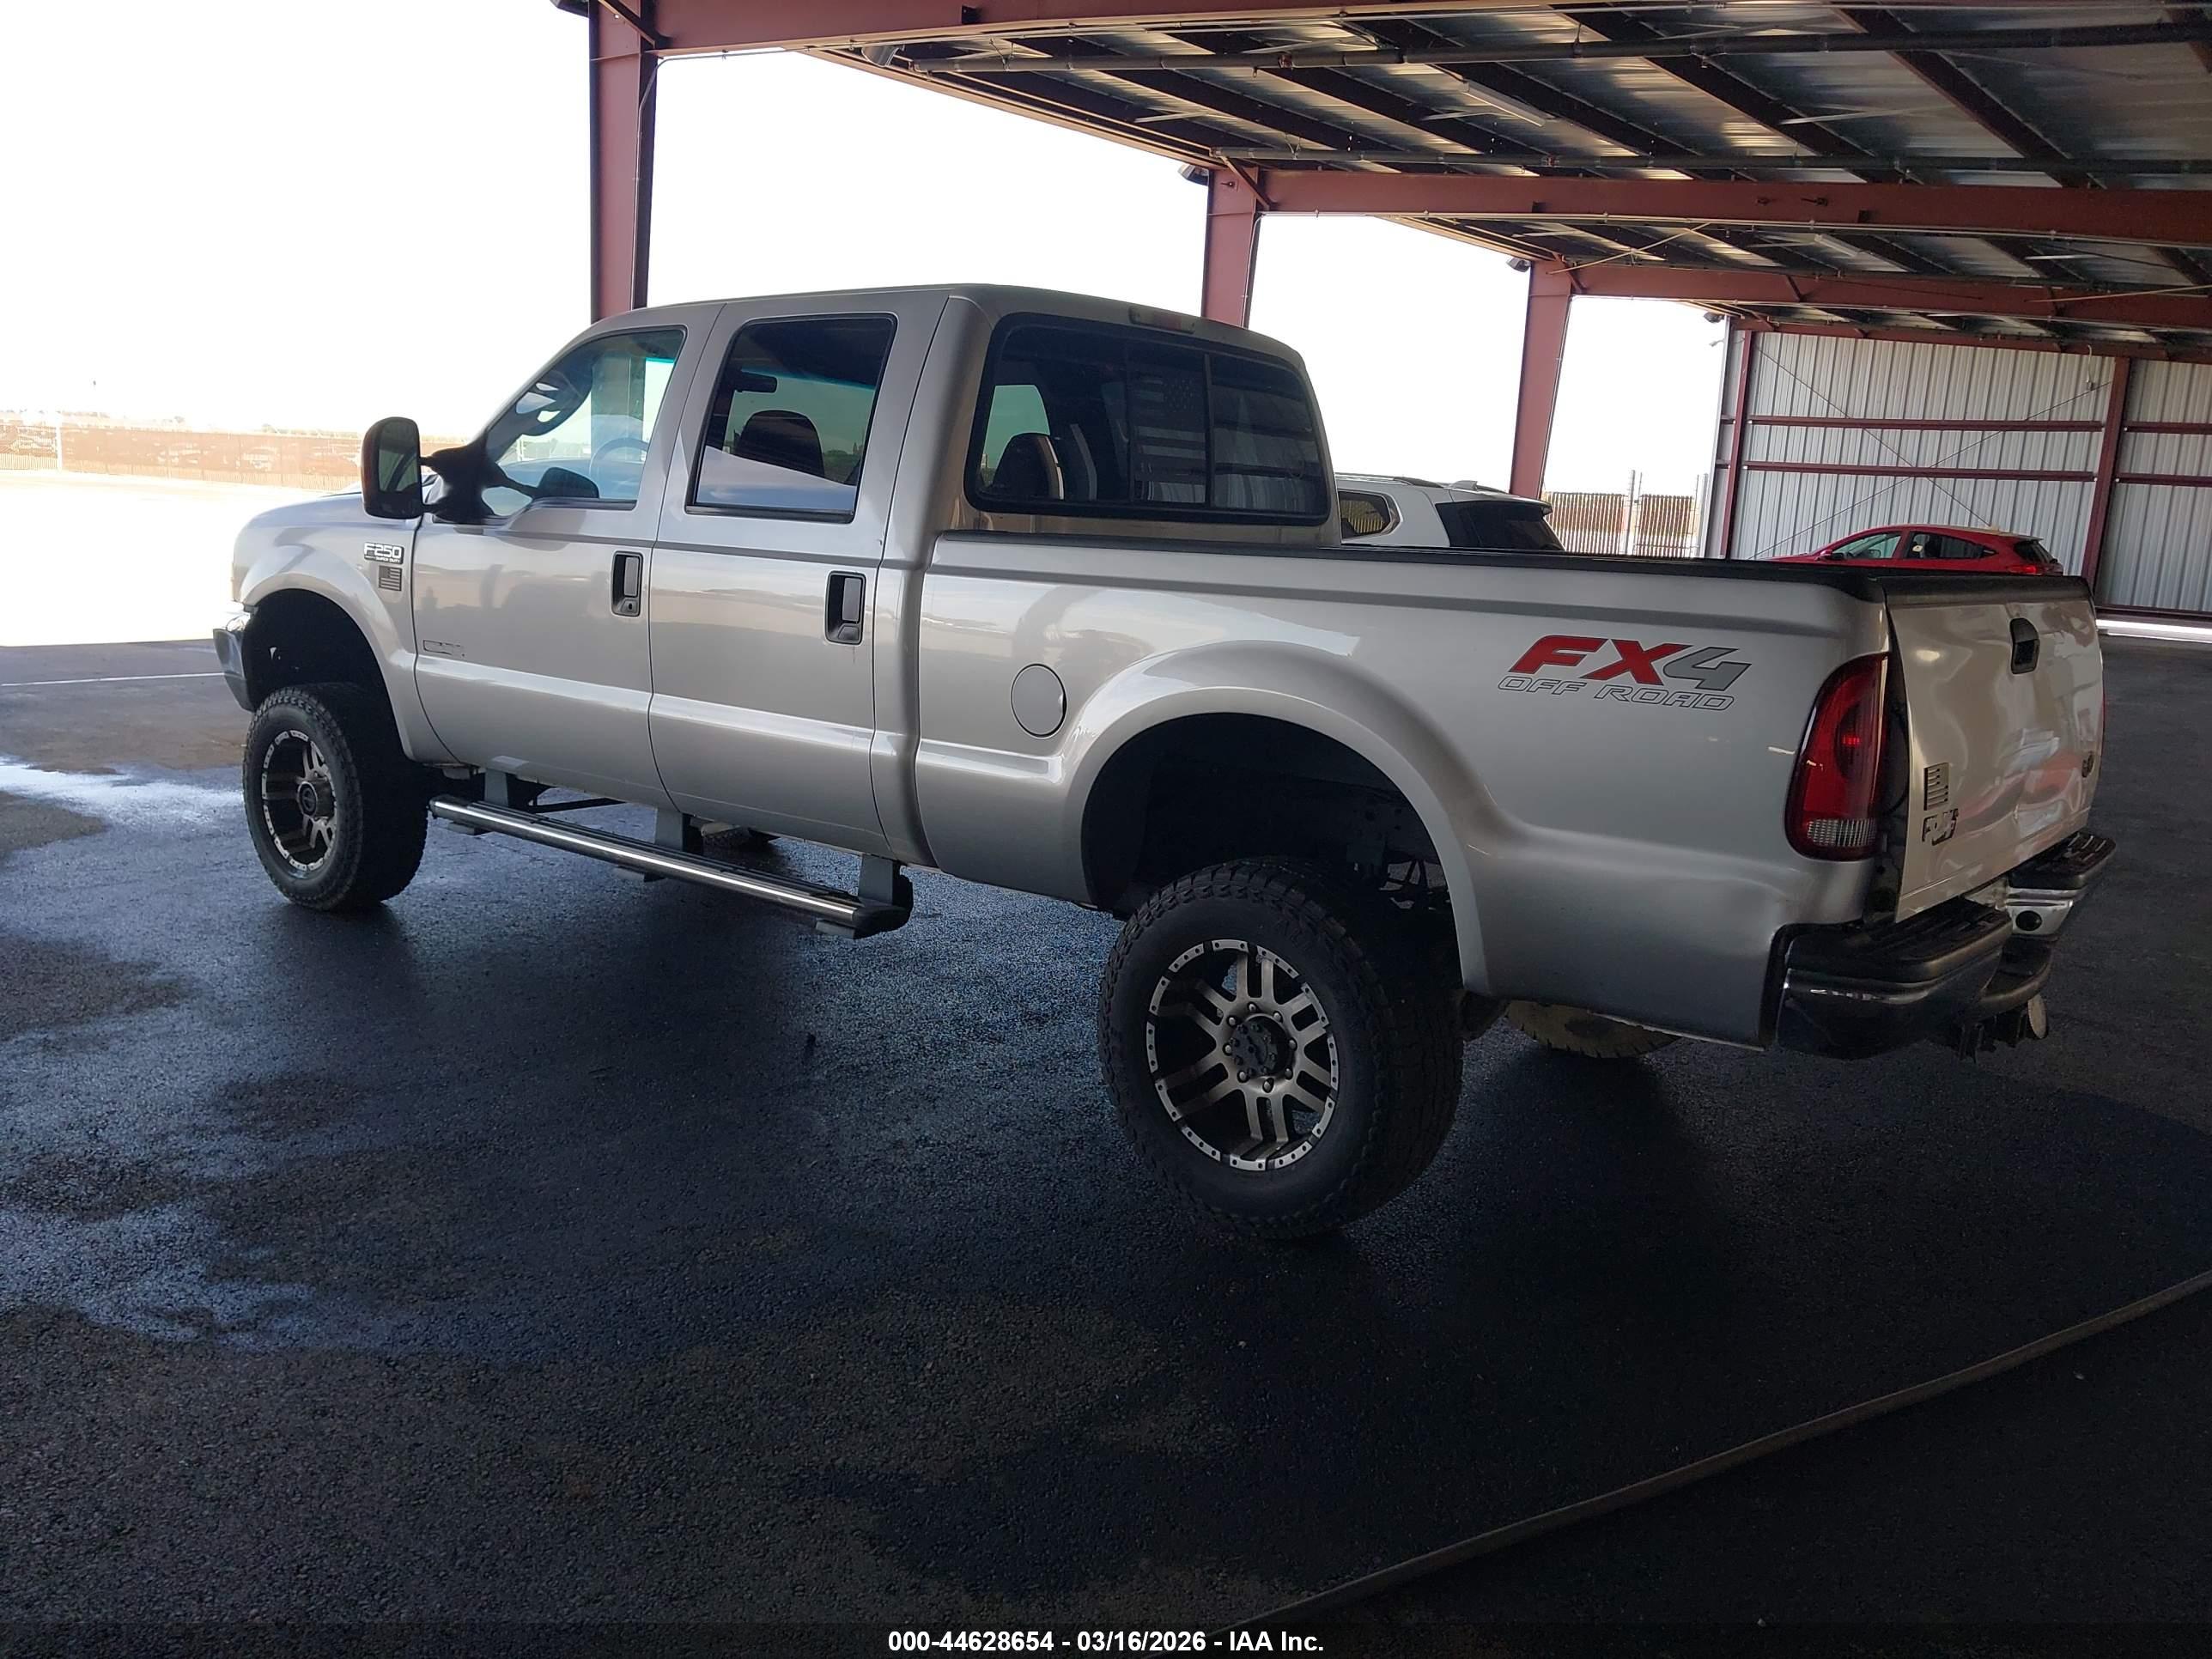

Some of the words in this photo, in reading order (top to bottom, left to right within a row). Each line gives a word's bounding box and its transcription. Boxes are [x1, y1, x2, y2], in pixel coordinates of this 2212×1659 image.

[364, 543, 402, 559] F250
[1508, 635, 1753, 691] FX4
[1498, 675, 1588, 696] OFF
[1594, 684, 1735, 711] ROAD
